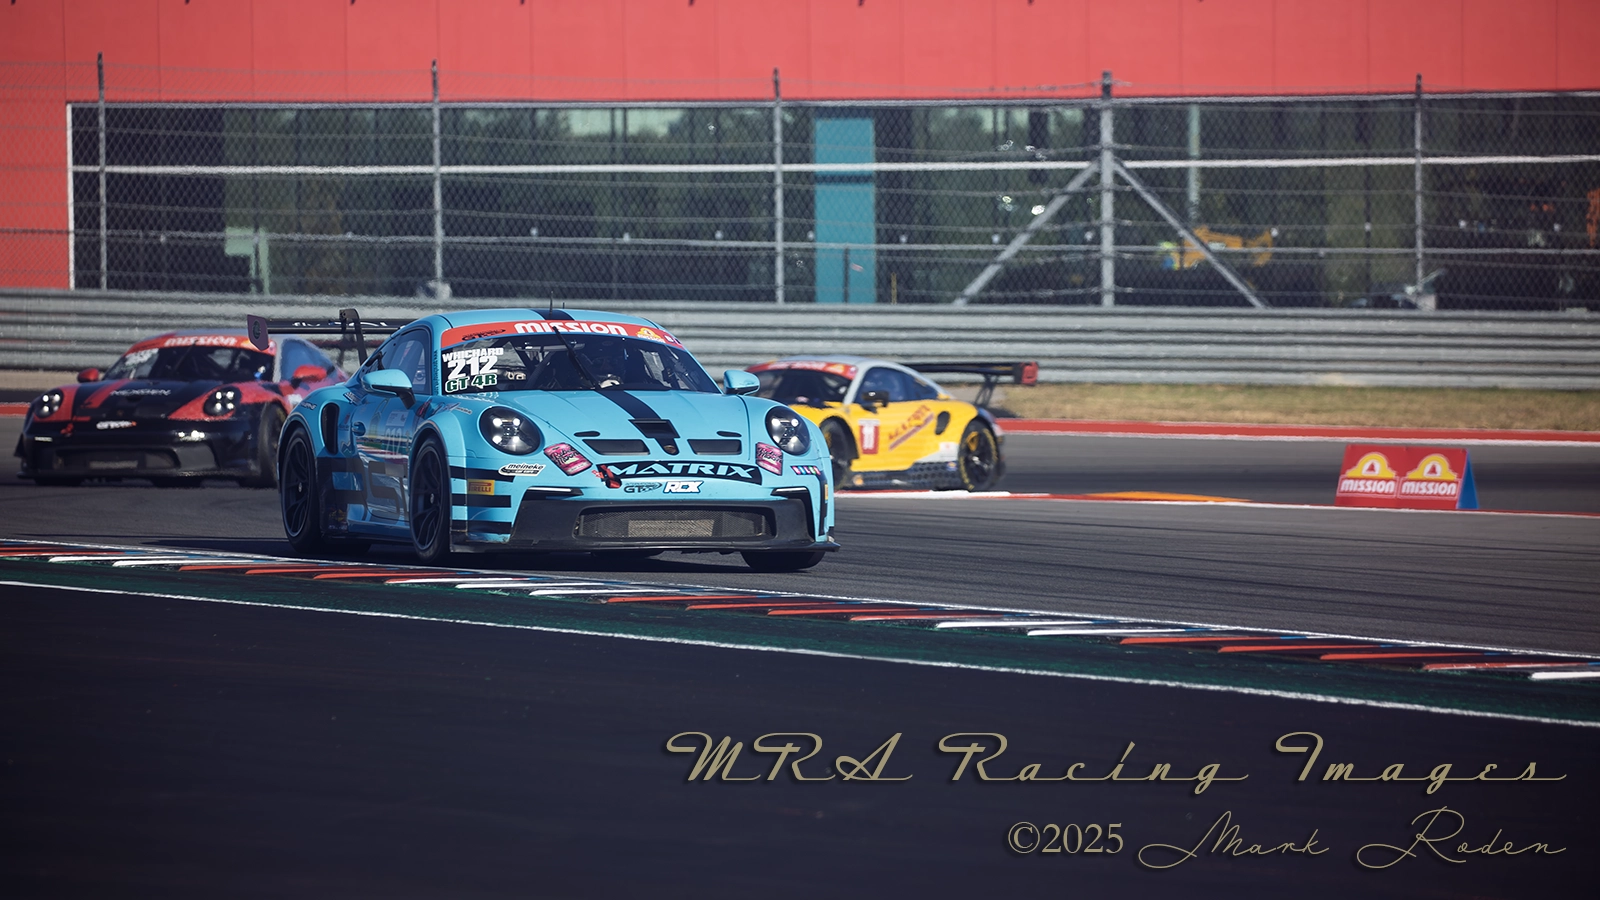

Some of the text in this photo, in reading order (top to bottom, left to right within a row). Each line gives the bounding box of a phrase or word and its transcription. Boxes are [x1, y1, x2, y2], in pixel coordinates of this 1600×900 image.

[441, 347, 504, 362] WHICHARD
[447, 355, 499, 380] 212
[445, 373, 498, 393] GT 4R
[608, 463, 755, 479] MATRIX
[1340, 479, 1457, 495] MISSION MISSION
